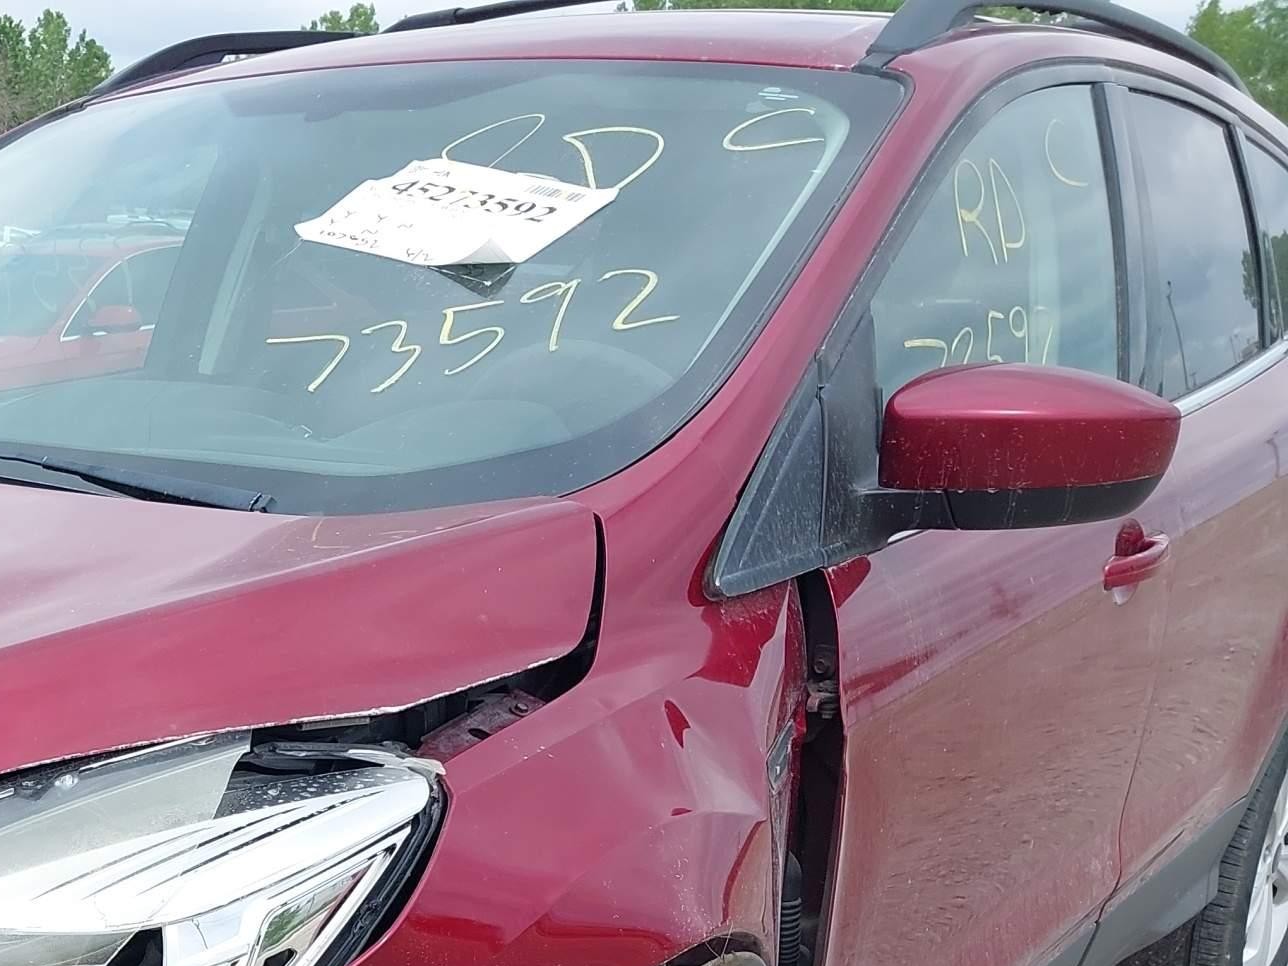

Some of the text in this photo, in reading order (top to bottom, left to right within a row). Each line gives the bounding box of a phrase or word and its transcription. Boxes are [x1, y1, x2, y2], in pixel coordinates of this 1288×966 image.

[391, 179, 558, 223] 45273592
[954, 158, 1026, 265] RD
[266, 268, 680, 394] 73592
